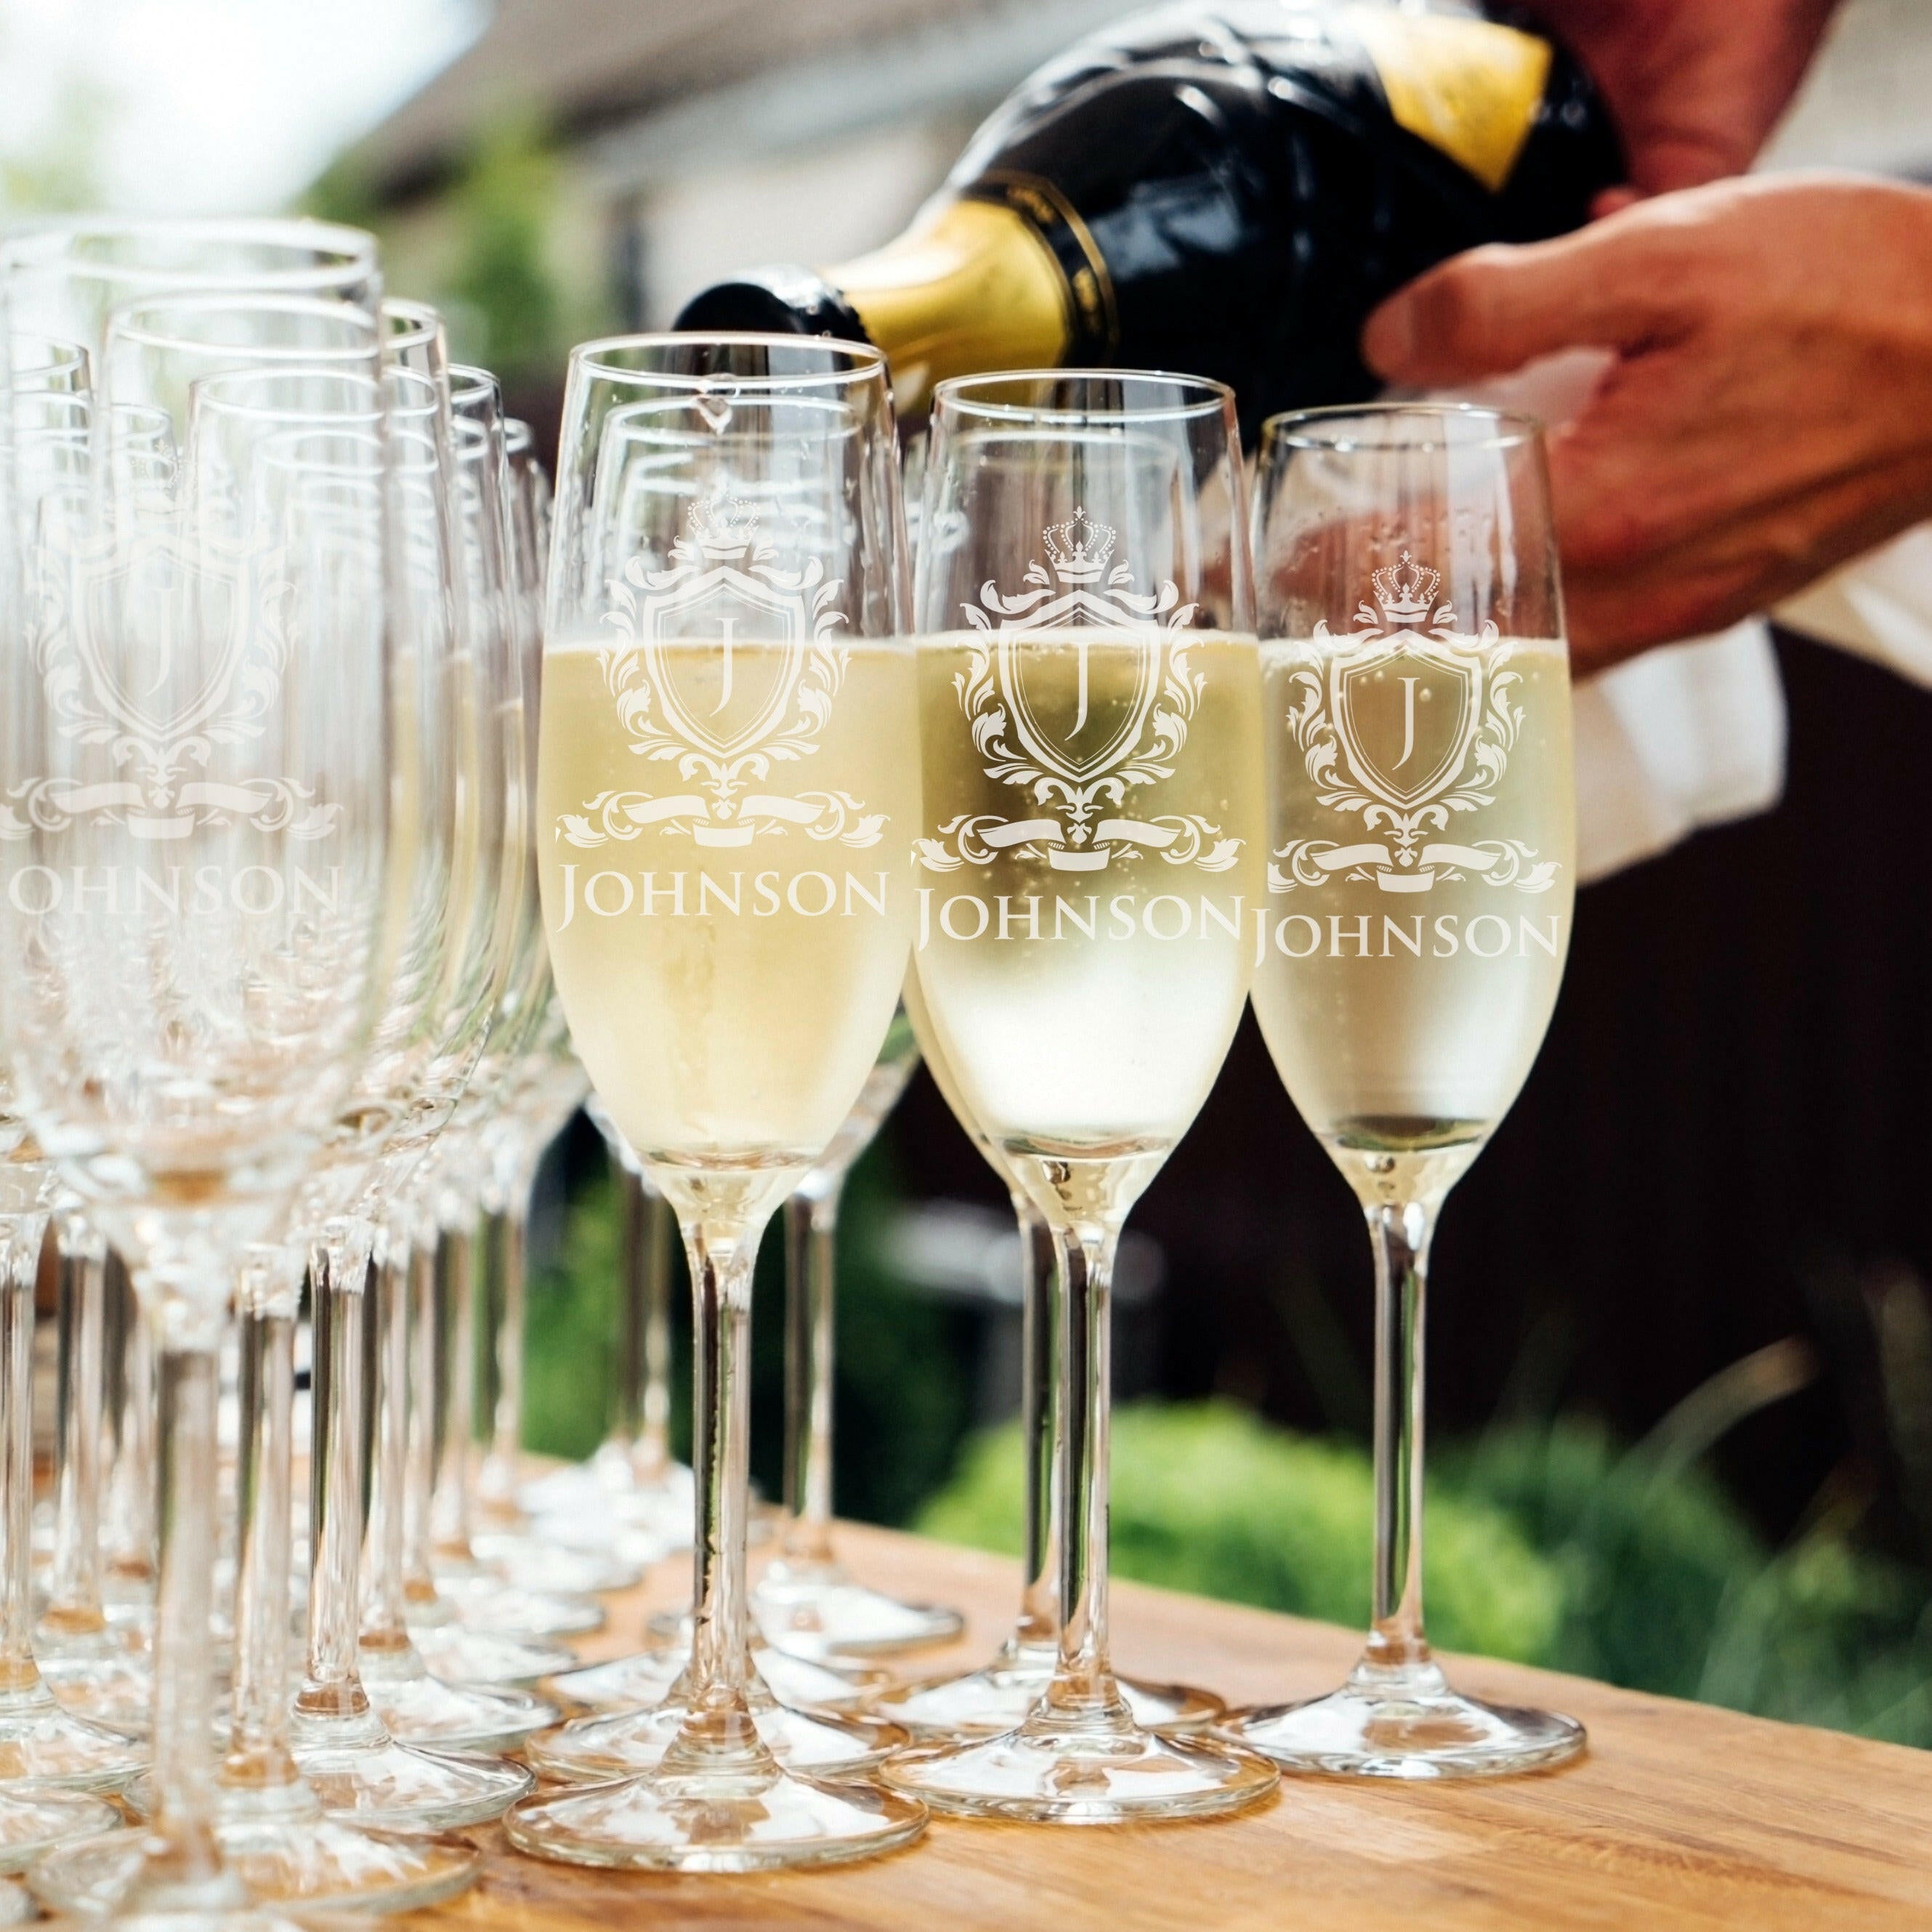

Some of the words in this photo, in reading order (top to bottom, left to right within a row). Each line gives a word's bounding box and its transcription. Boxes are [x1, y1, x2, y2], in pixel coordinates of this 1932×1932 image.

[710, 618, 740, 717] J
[1064, 641, 1094, 741] J
[1392, 676, 1421, 770] J
[1, 865, 342, 915] OHNSON
[556, 864, 889, 933] JOHNSON
[913, 888, 1246, 953] JOHNSON
[1250, 908, 1563, 968] JOHNSON
